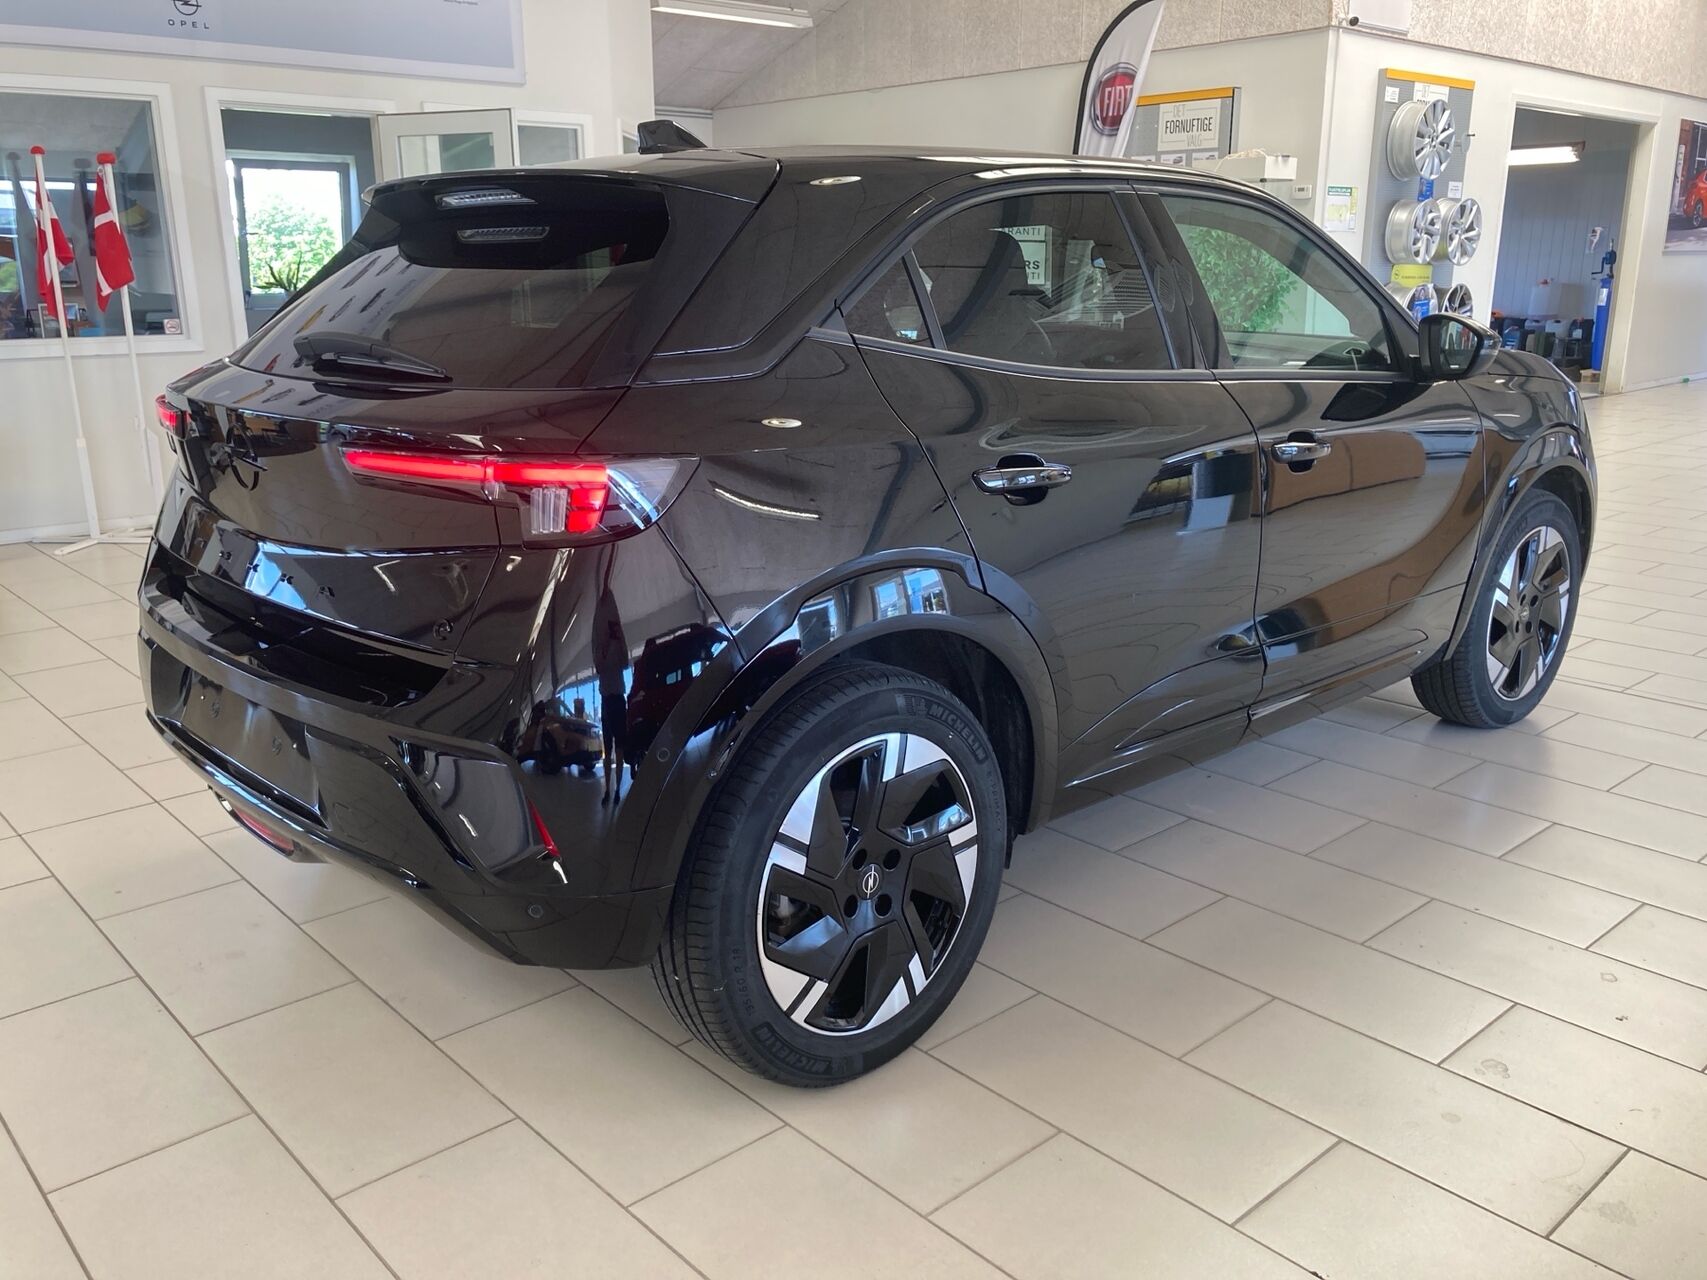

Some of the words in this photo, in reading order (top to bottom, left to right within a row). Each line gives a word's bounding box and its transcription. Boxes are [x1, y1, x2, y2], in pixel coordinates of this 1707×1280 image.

[167, 19, 209, 30] OPEL
[1103, 84, 1133, 118] FIAT
[1164, 116, 1213, 135] FORNUFTIGE
[929, 703, 986, 761] MICHELIN
